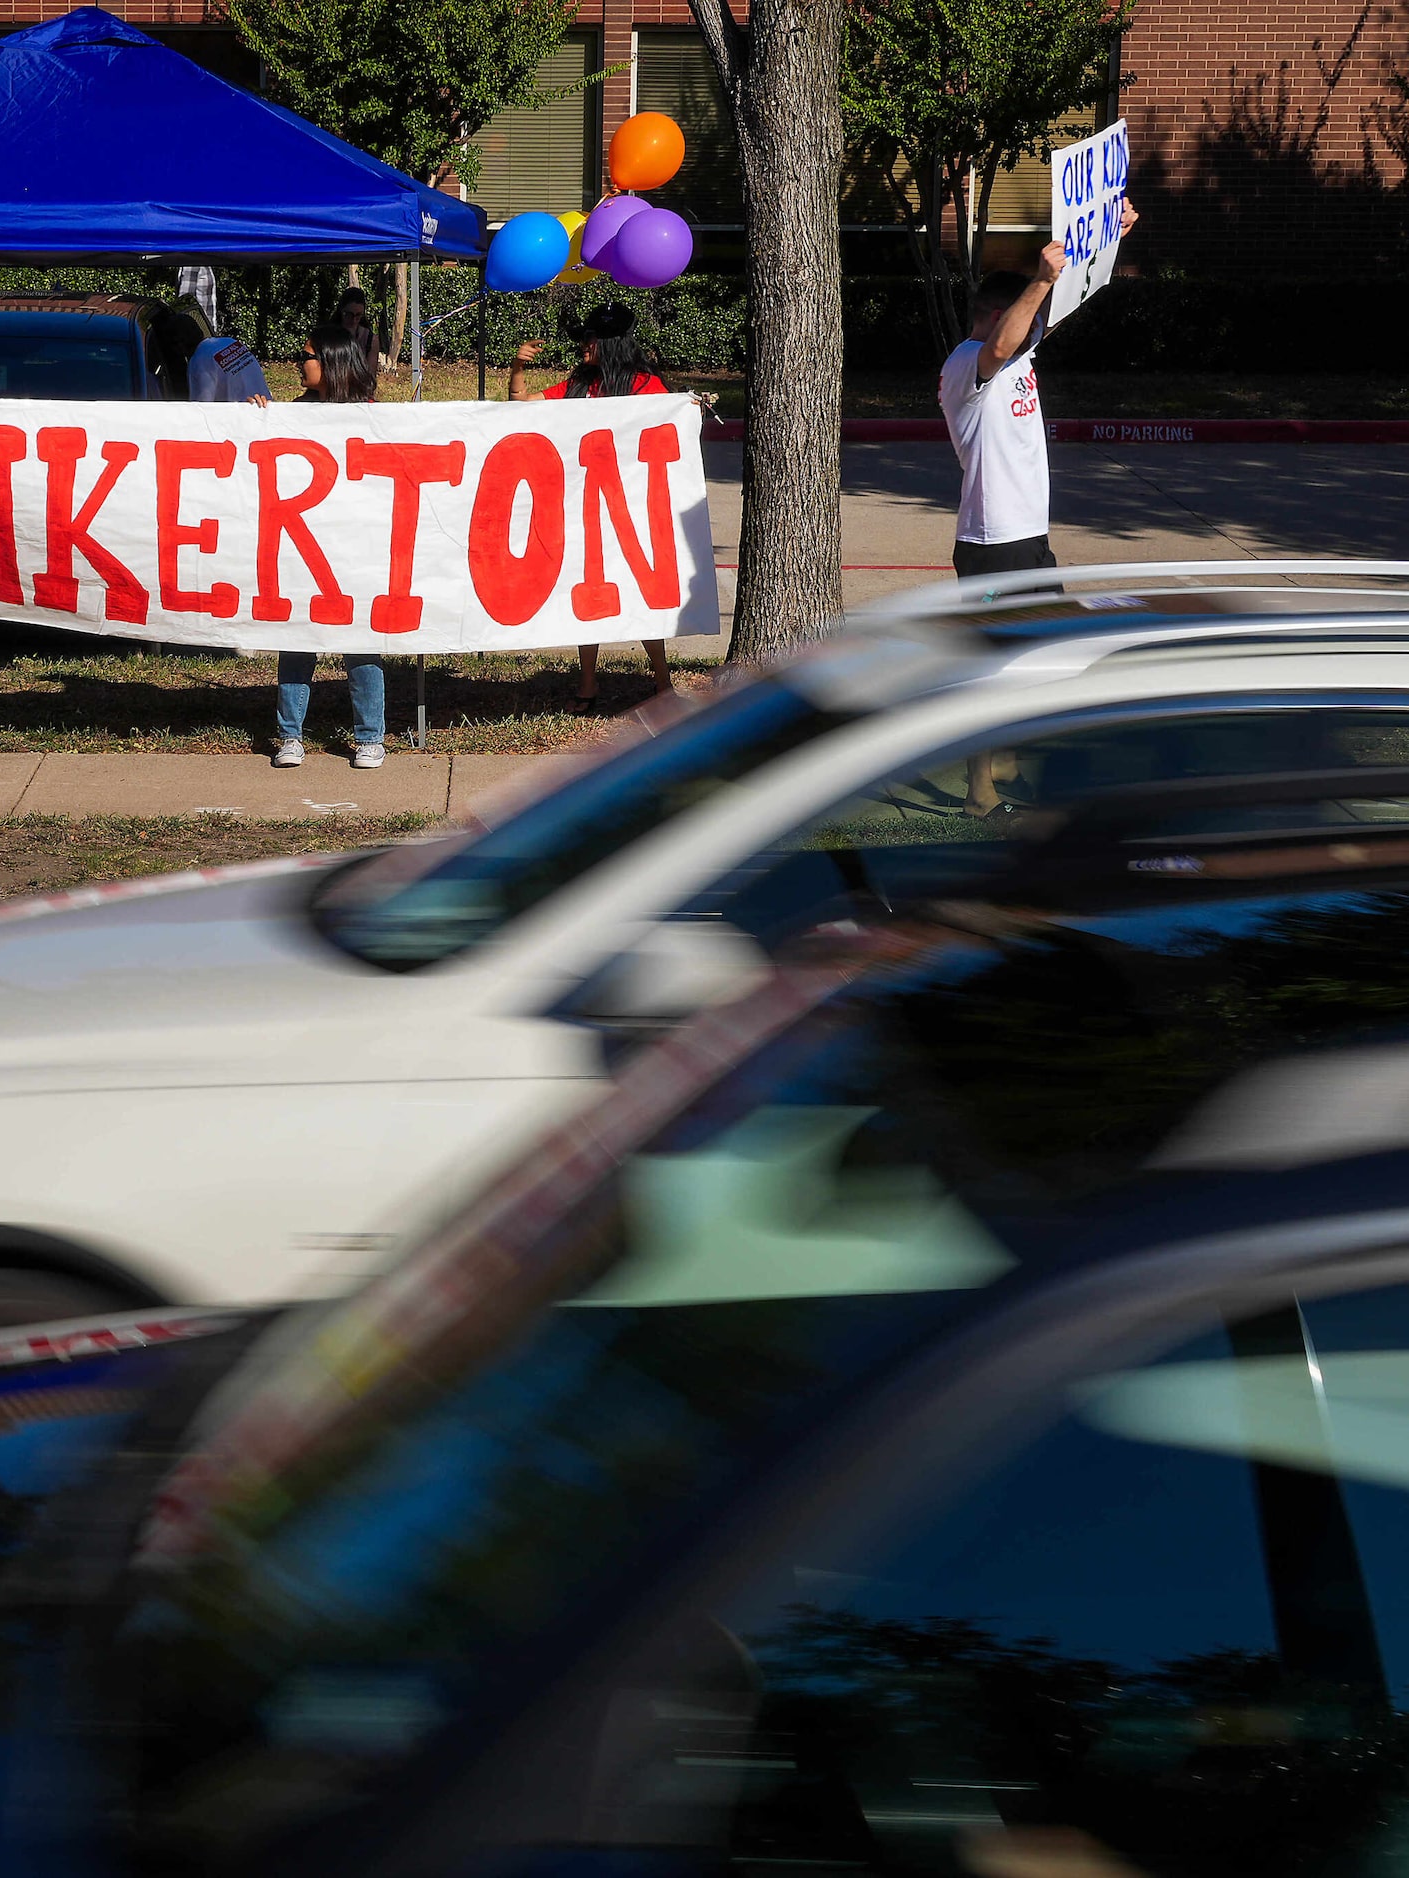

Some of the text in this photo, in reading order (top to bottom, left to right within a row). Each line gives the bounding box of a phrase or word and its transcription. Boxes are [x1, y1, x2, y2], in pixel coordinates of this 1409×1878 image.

[1062, 146, 1094, 207] OUR
[1059, 190, 1126, 273] ARE NOT
[1092, 424, 1194, 441] NO PARKING
